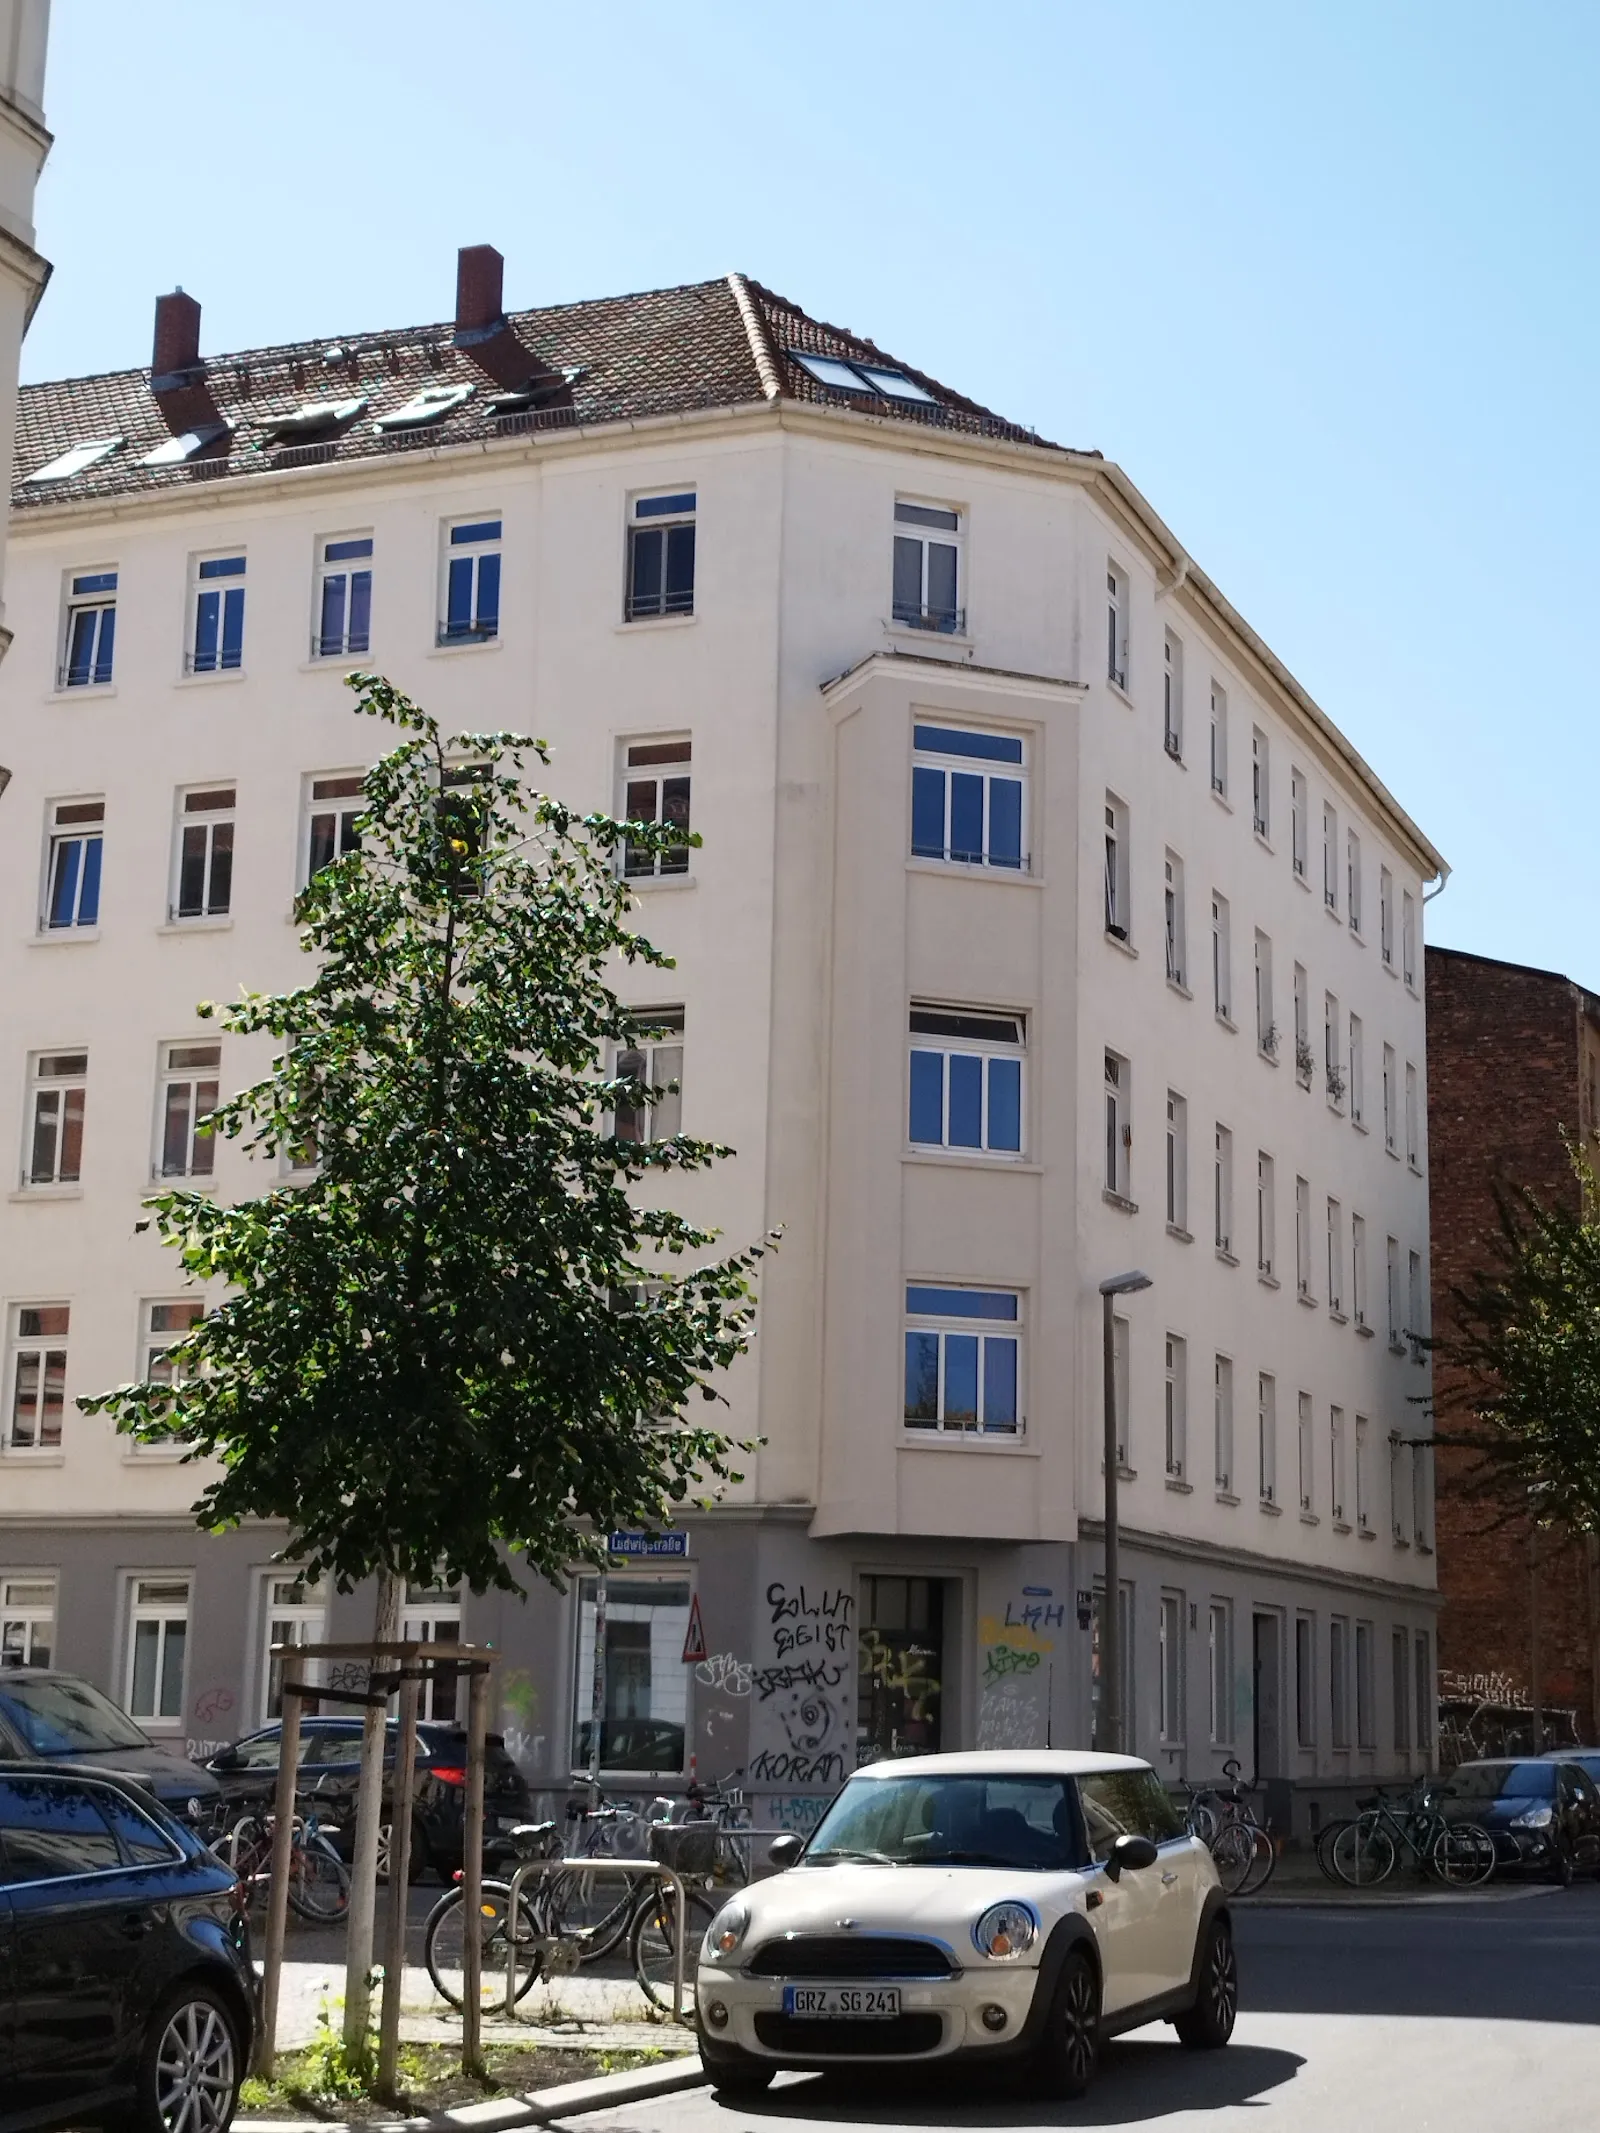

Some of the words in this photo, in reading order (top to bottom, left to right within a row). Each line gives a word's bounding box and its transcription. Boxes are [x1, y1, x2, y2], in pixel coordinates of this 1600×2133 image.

[611, 1536, 682, 1554] Ludwigstraße
[795, 1991, 826, 2012] GRZ
[840, 1991, 861, 2012] SG
[865, 1991, 897, 2013] 241
